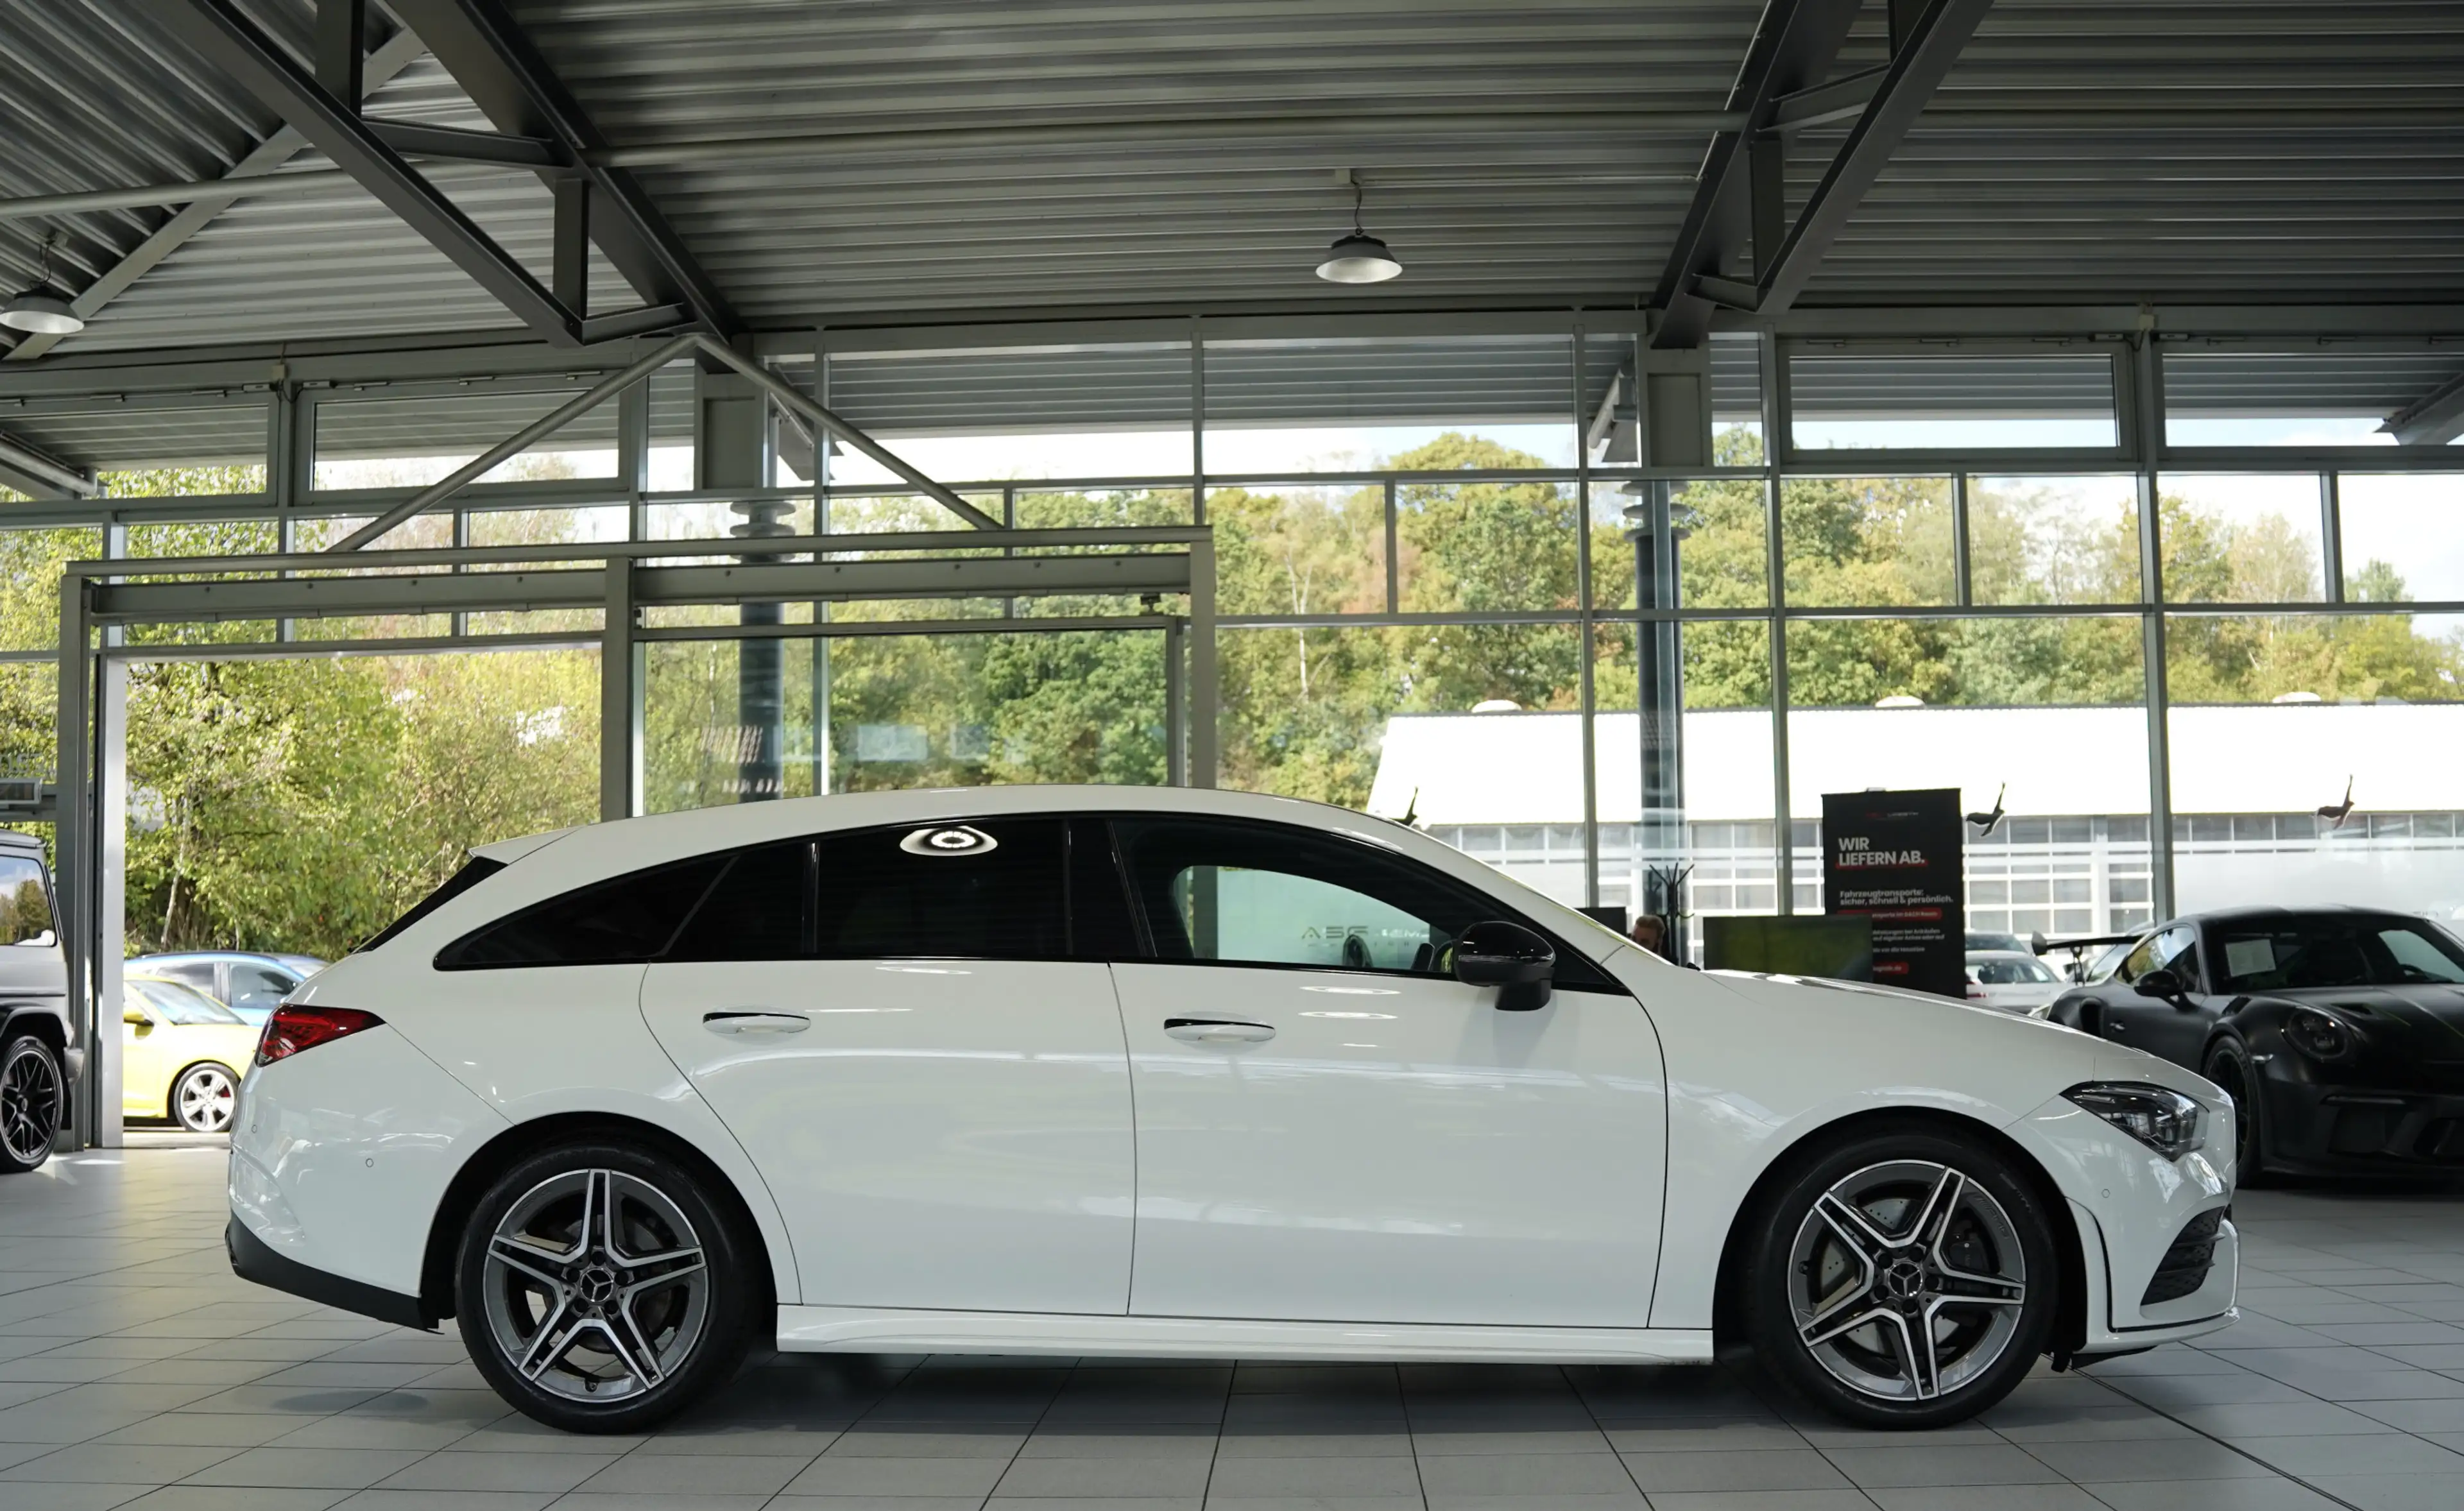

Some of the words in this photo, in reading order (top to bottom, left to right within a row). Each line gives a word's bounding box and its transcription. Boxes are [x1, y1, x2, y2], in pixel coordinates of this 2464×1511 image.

[1838, 837, 1870, 851] WIR
[1838, 851, 1897, 867] LIEFERN
[1898, 850, 1926, 865] AB.
